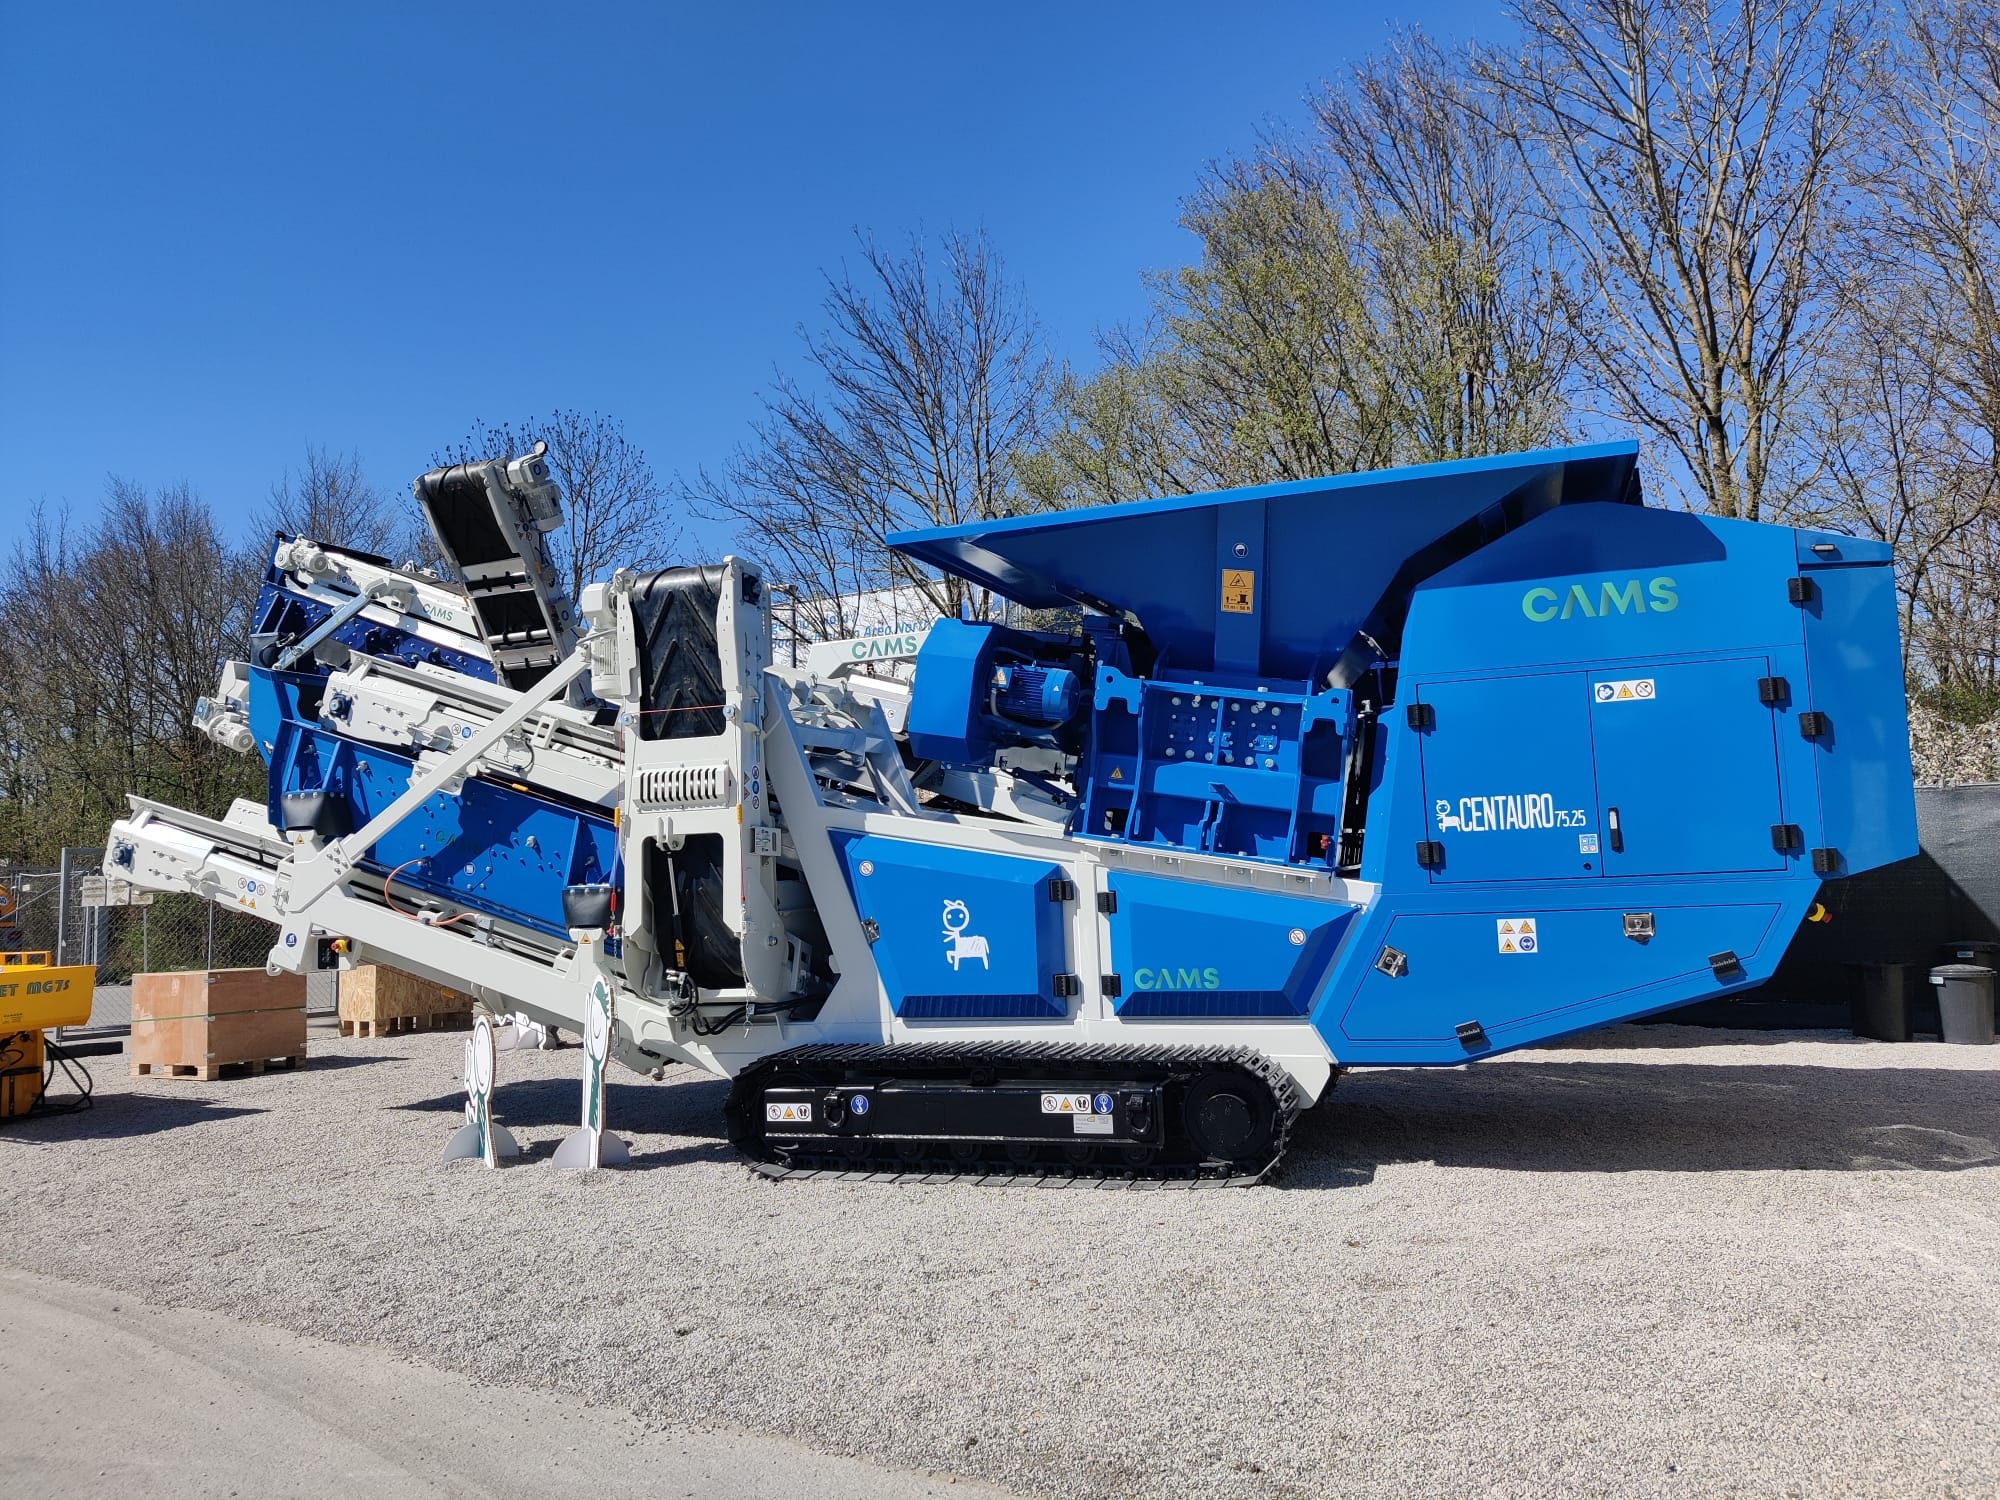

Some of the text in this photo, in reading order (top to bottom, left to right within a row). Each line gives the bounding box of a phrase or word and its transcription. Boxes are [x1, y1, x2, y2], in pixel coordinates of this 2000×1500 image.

[1522, 577, 1679, 623] CAMS
[423, 603, 453, 622] CAMS
[851, 636, 918, 660] CAMS
[1459, 793, 1586, 832] CENTAURO 75.25
[1134, 967, 1220, 990] CAMS
